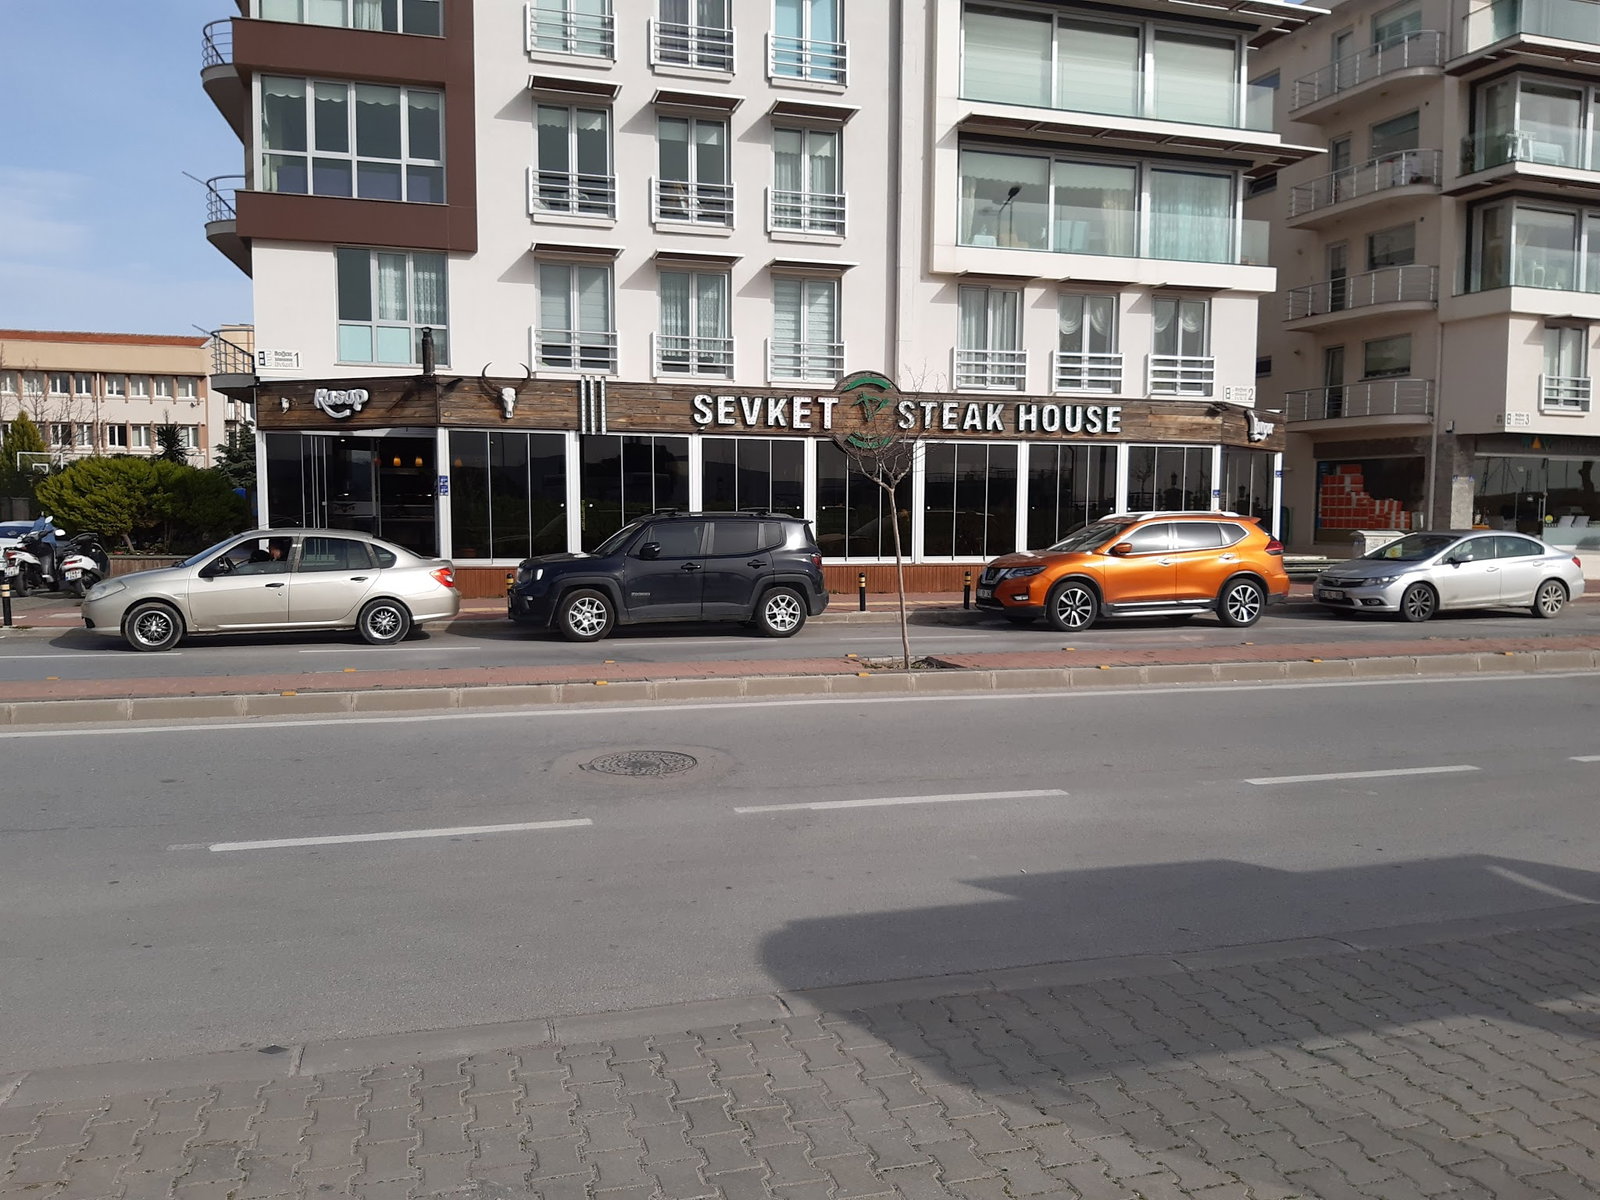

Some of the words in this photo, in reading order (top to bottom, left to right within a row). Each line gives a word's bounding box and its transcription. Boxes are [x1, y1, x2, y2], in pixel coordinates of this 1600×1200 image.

[1248, 388, 1254, 401] 2
[693, 394, 840, 430] ŞEVKET
[898, 400, 1005, 430] STEAK
[1018, 403, 1123, 433] HOUSE
